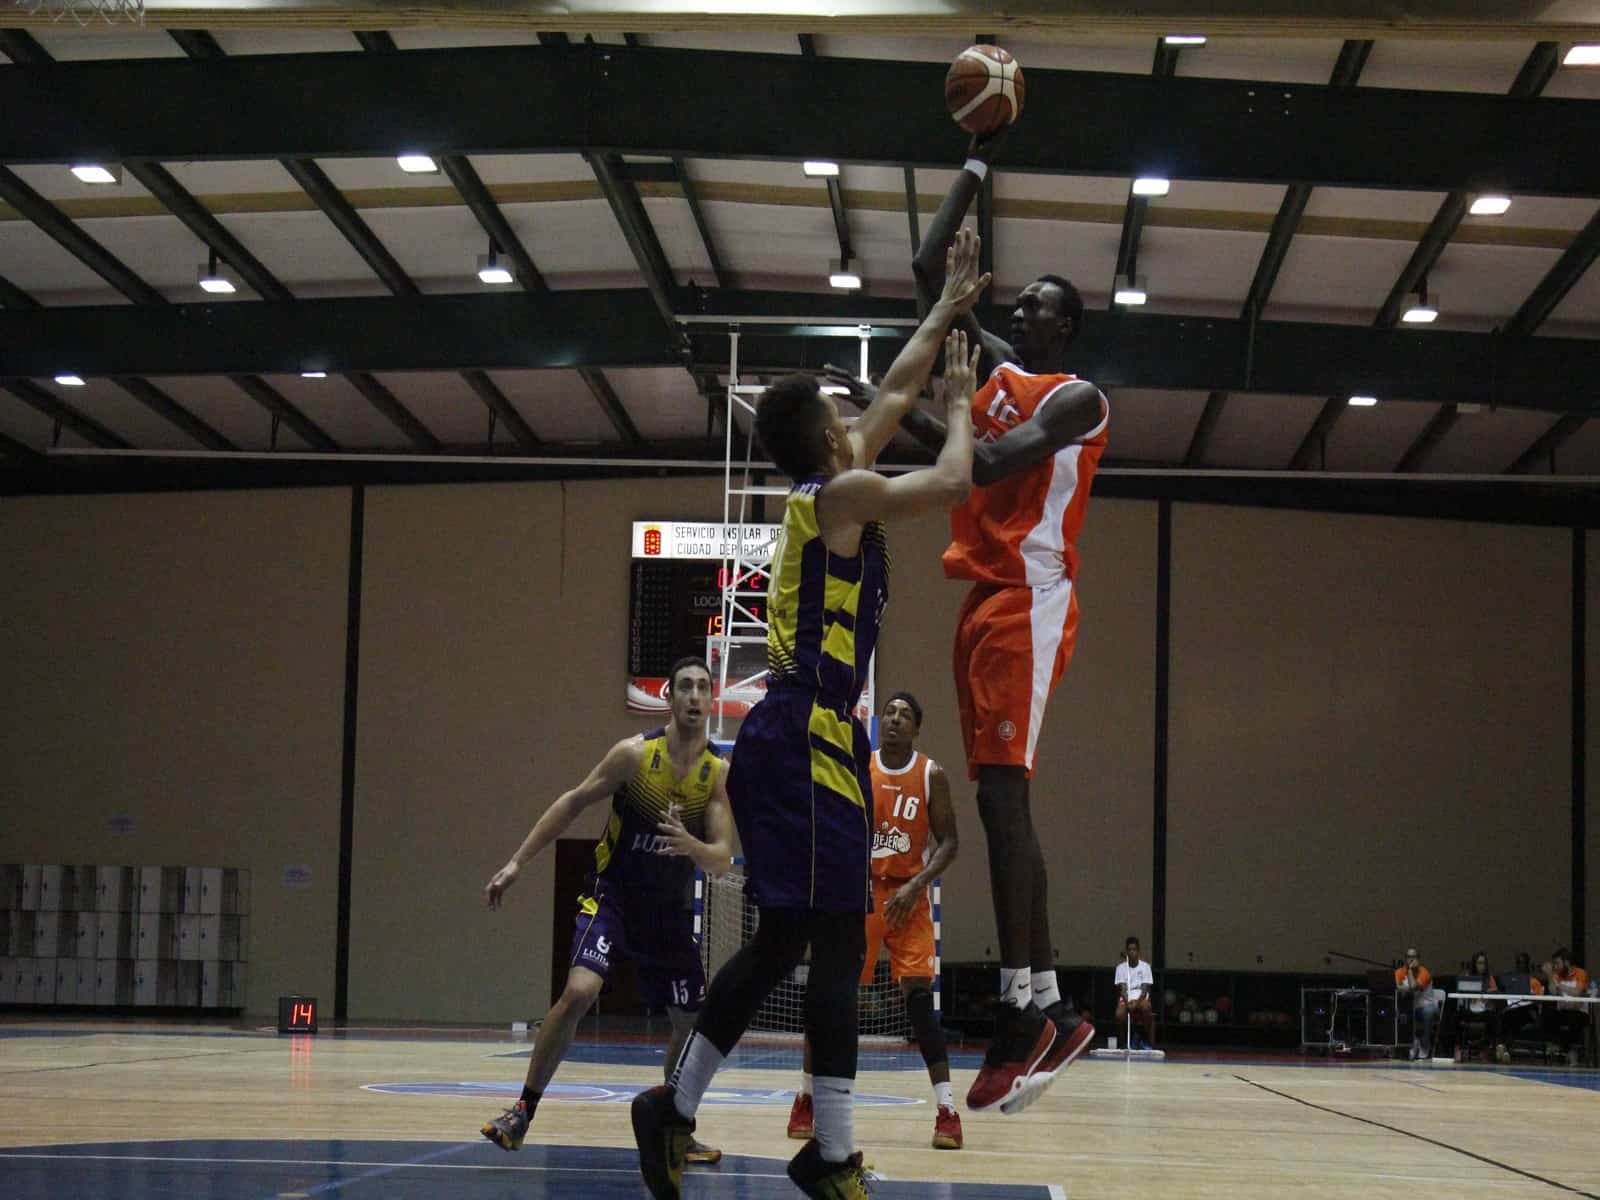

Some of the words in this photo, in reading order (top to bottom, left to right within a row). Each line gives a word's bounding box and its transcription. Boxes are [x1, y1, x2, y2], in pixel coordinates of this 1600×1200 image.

[675, 525, 715, 539] SERVICIO
[677, 543, 711, 556] CIUDAD
[694, 595, 723, 608] LOCA
[892, 793, 920, 821] 16
[671, 978, 689, 1006] 15
[292, 1003, 313, 1025] 14
